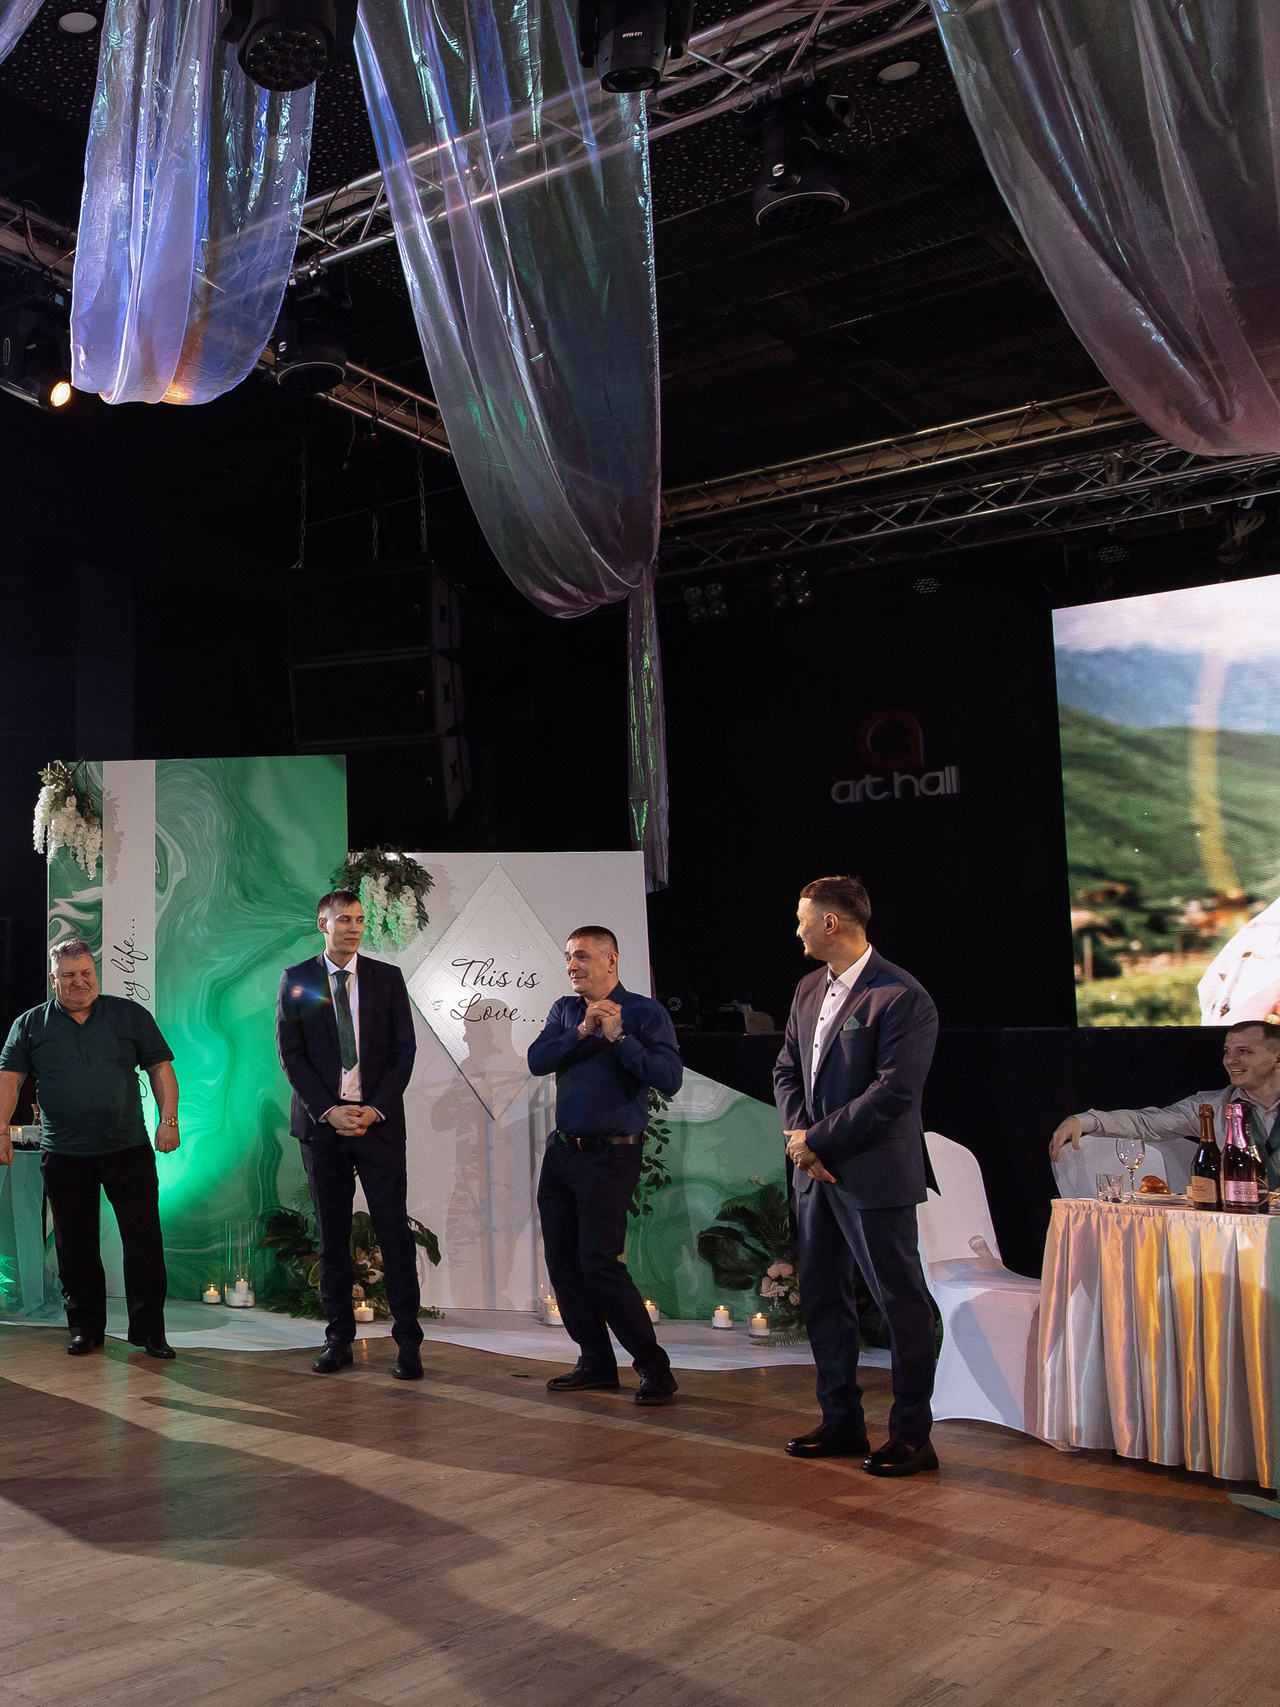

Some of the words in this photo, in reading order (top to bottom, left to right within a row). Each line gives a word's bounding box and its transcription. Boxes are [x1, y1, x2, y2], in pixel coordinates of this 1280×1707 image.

[830, 774, 890, 804] art
[893, 766, 961, 799] hall
[110, 918, 149, 974] life...
[451, 958, 513, 988] This
[516, 971, 541, 989] is
[449, 992, 545, 1023] Love...
